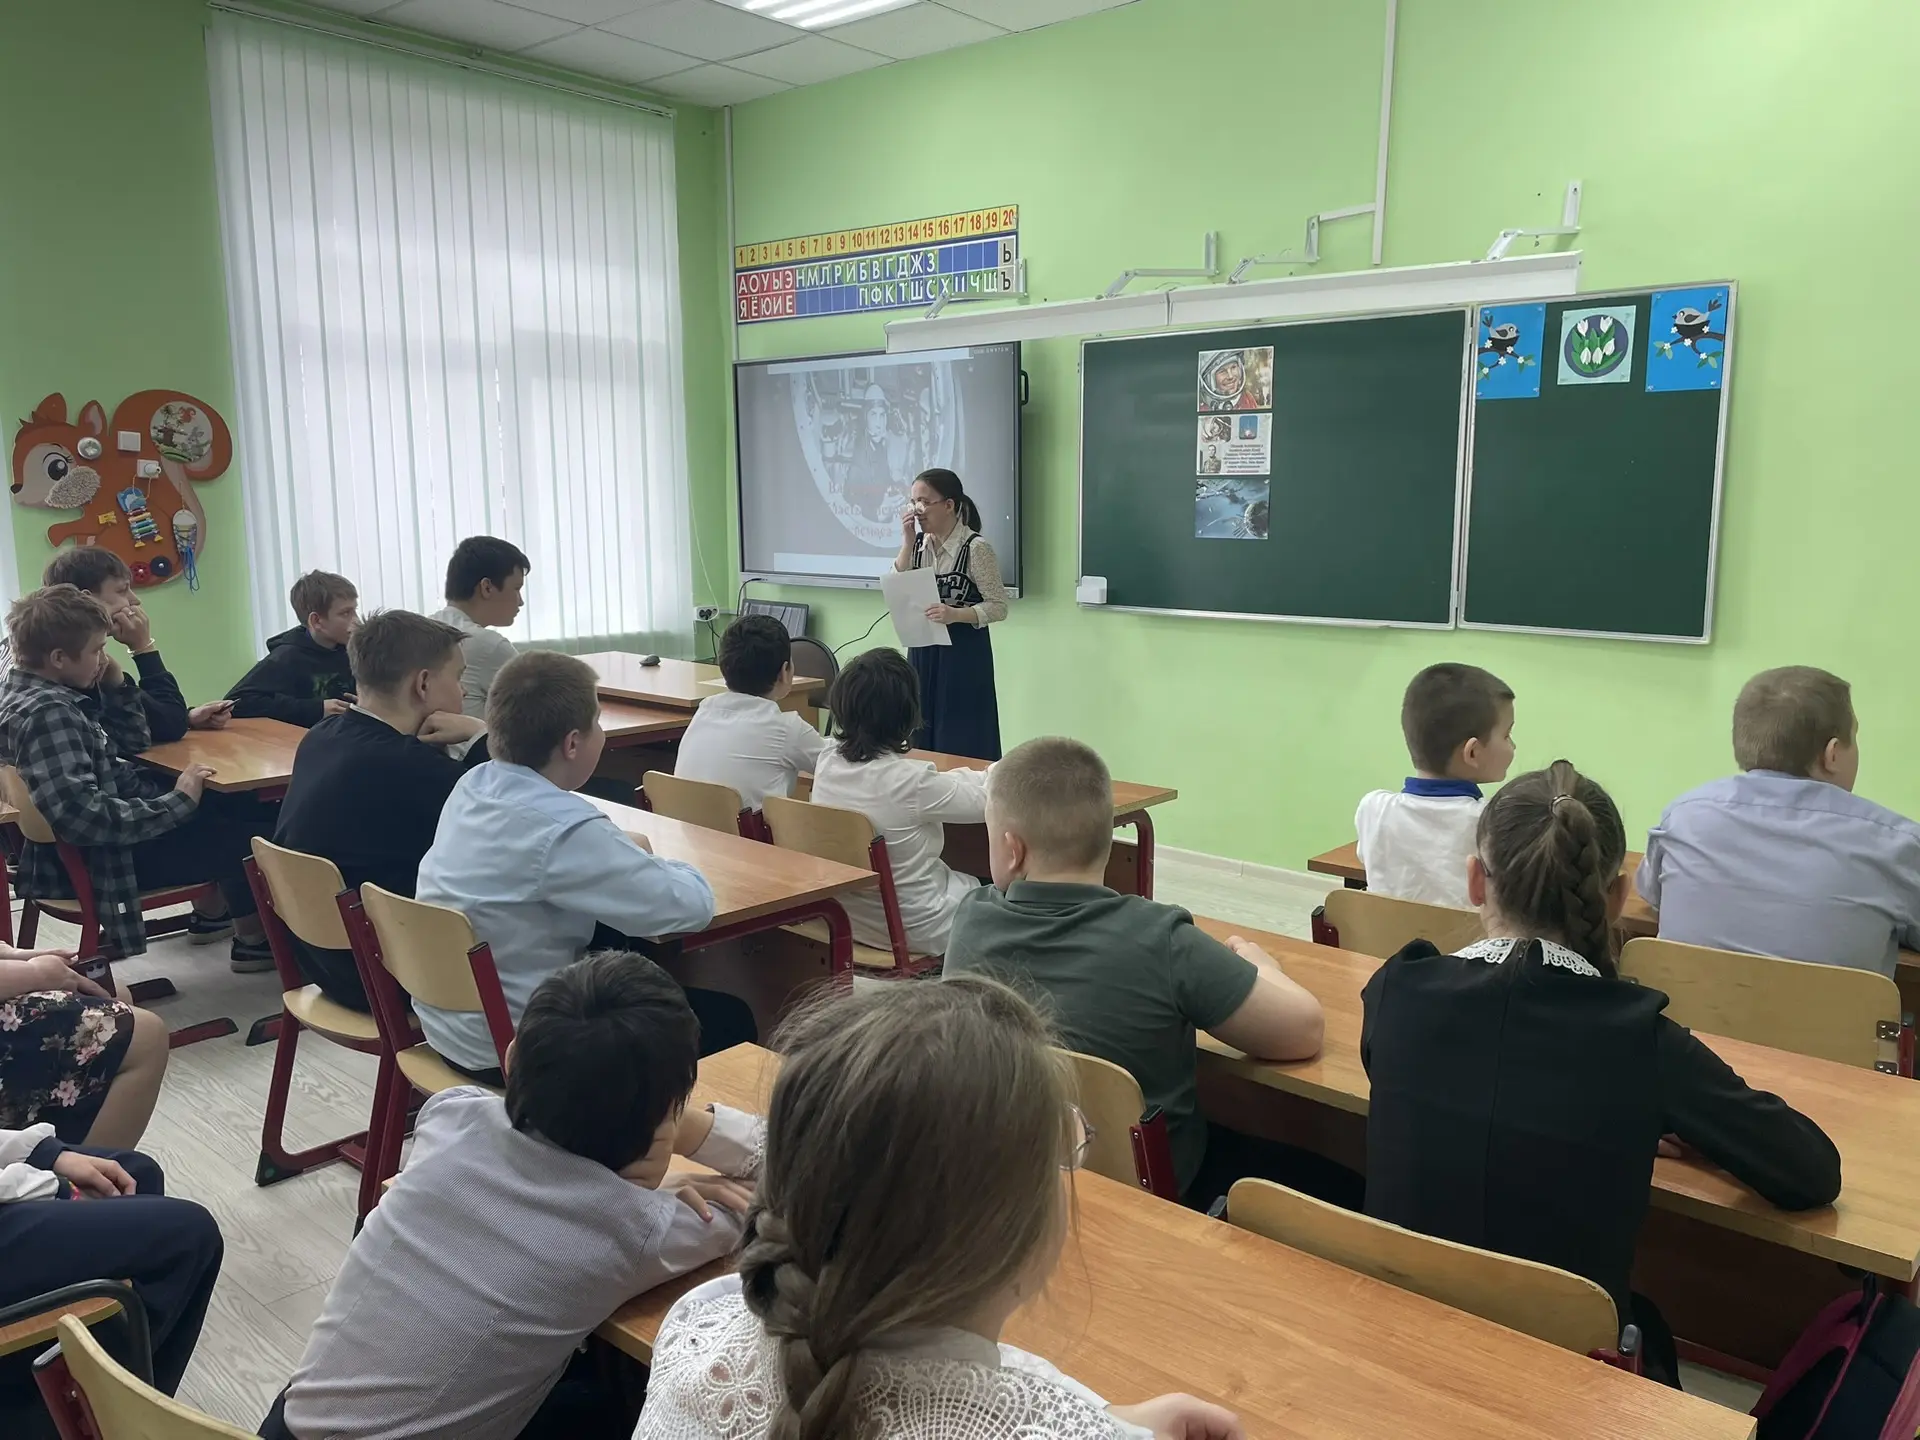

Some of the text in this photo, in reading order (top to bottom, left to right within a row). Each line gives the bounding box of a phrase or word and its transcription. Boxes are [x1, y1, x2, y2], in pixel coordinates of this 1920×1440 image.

[740, 209, 1014, 263] 1 2 3 4 5 6 7 8 9 10 11 12 13 14 15 16 17 18 19 20
